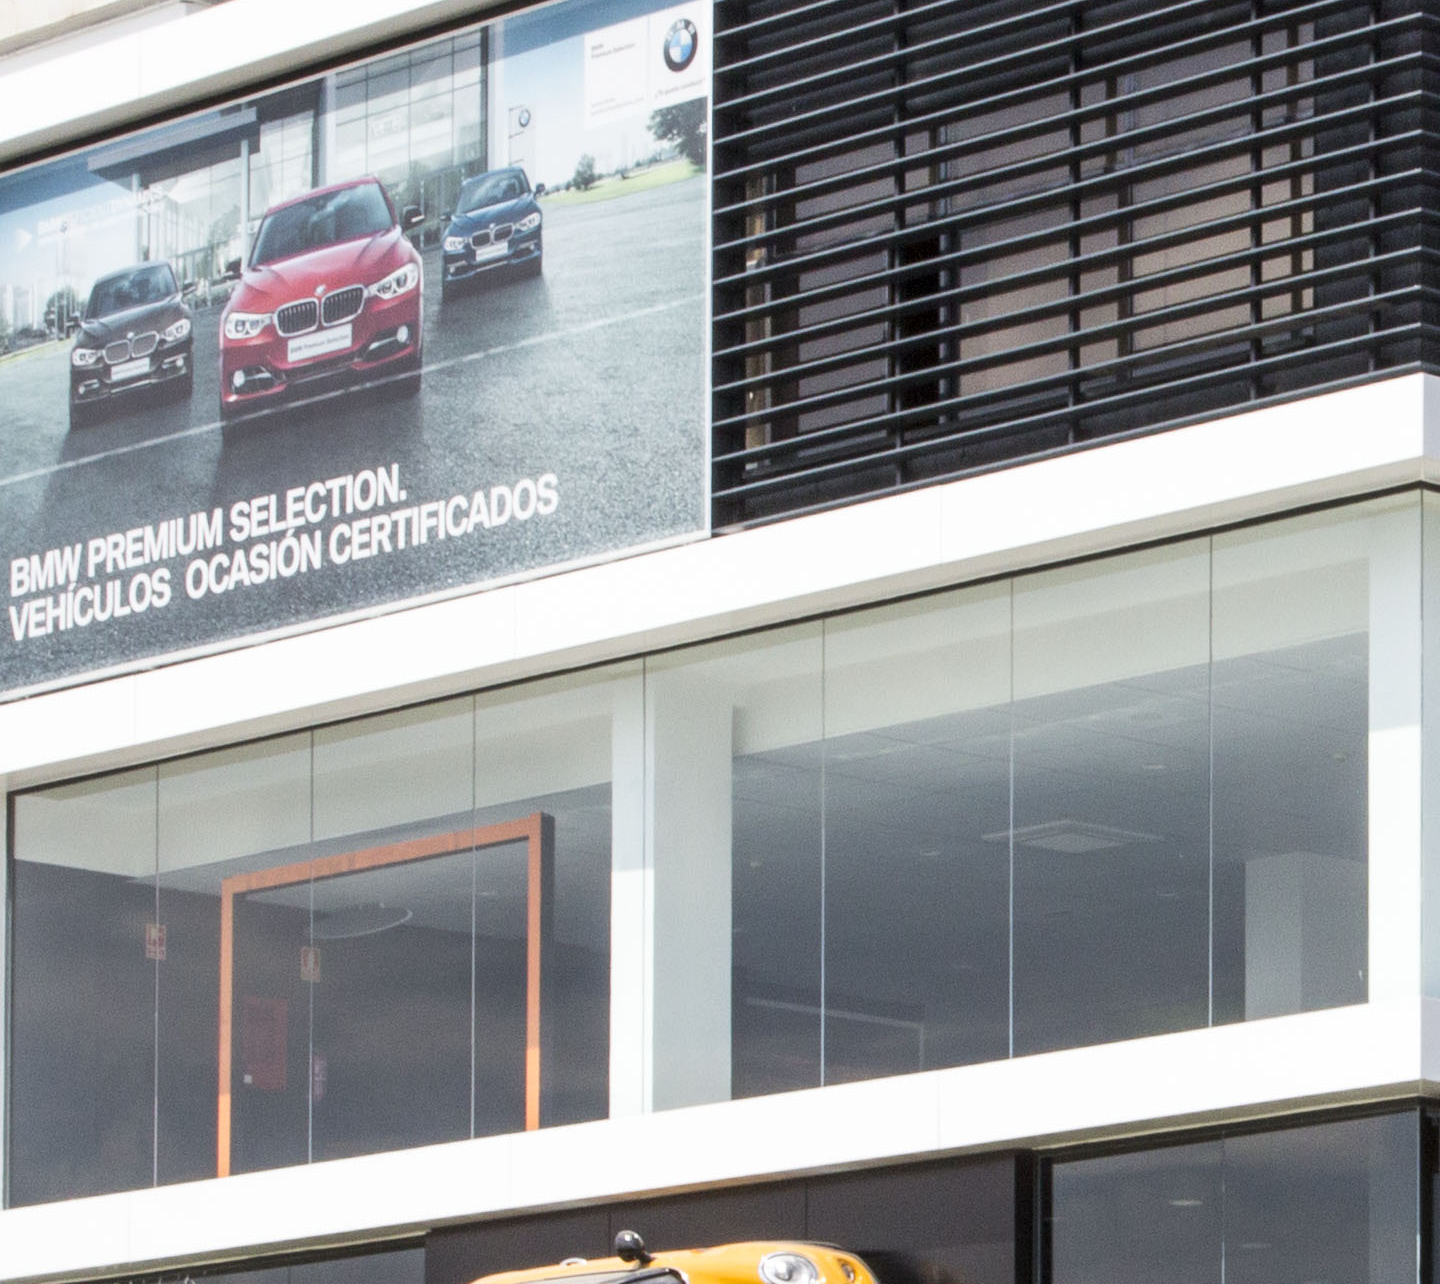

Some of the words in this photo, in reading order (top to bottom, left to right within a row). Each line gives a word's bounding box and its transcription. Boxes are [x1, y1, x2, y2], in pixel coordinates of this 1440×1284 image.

[9, 570, 172, 642] VEHÍCULOS
[185, 530, 323, 600] OCASIÓN
[328, 473, 560, 565] CERTIFICADOS
[10, 543, 83, 598] BMW
[88, 507, 223, 576] PREMIUM
[229, 463, 407, 544] SELECTION.
